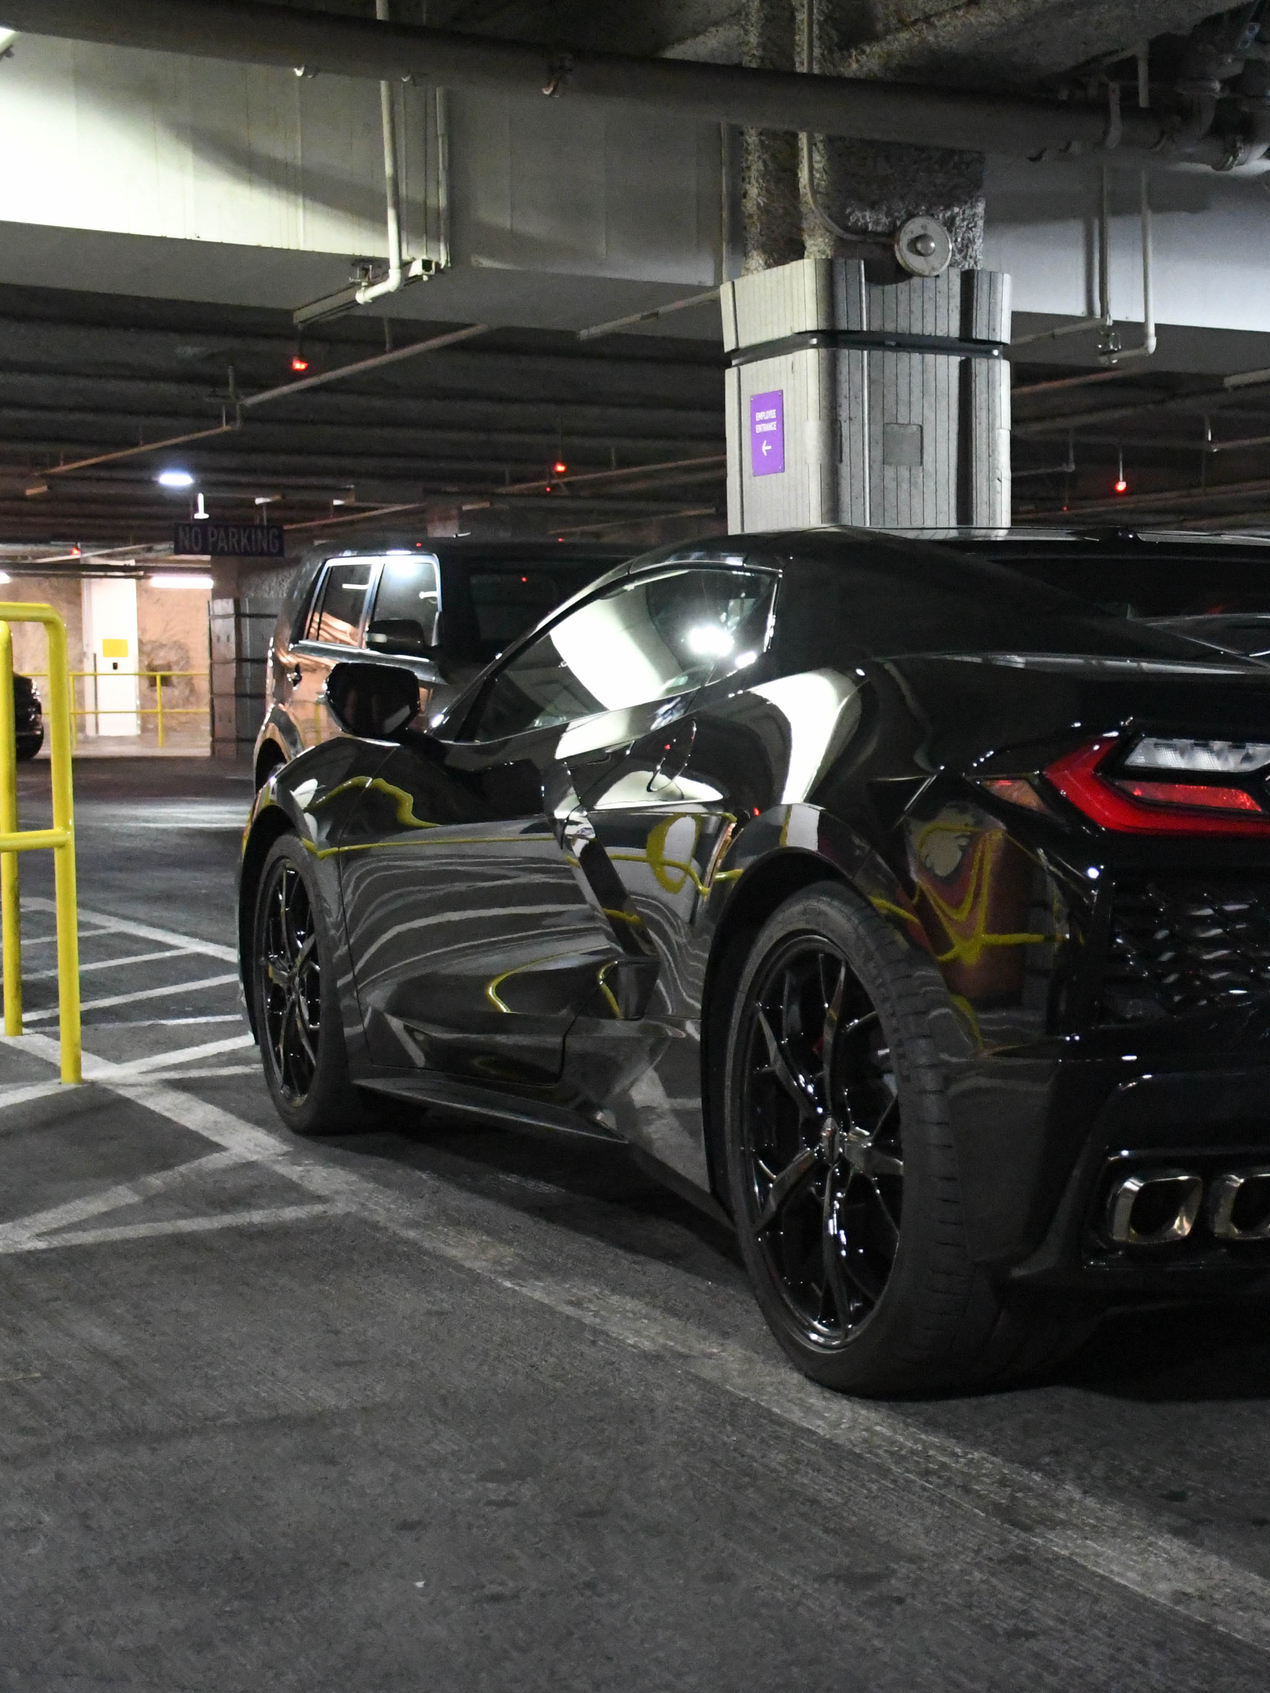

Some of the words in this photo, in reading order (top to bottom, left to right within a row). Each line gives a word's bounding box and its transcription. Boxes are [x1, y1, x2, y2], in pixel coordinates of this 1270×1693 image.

[755, 409, 777, 421] EMPLOYEE
[755, 421, 777, 434] ENTRANCE
[178, 525, 202, 552] NO
[208, 526, 279, 553] PARKING
